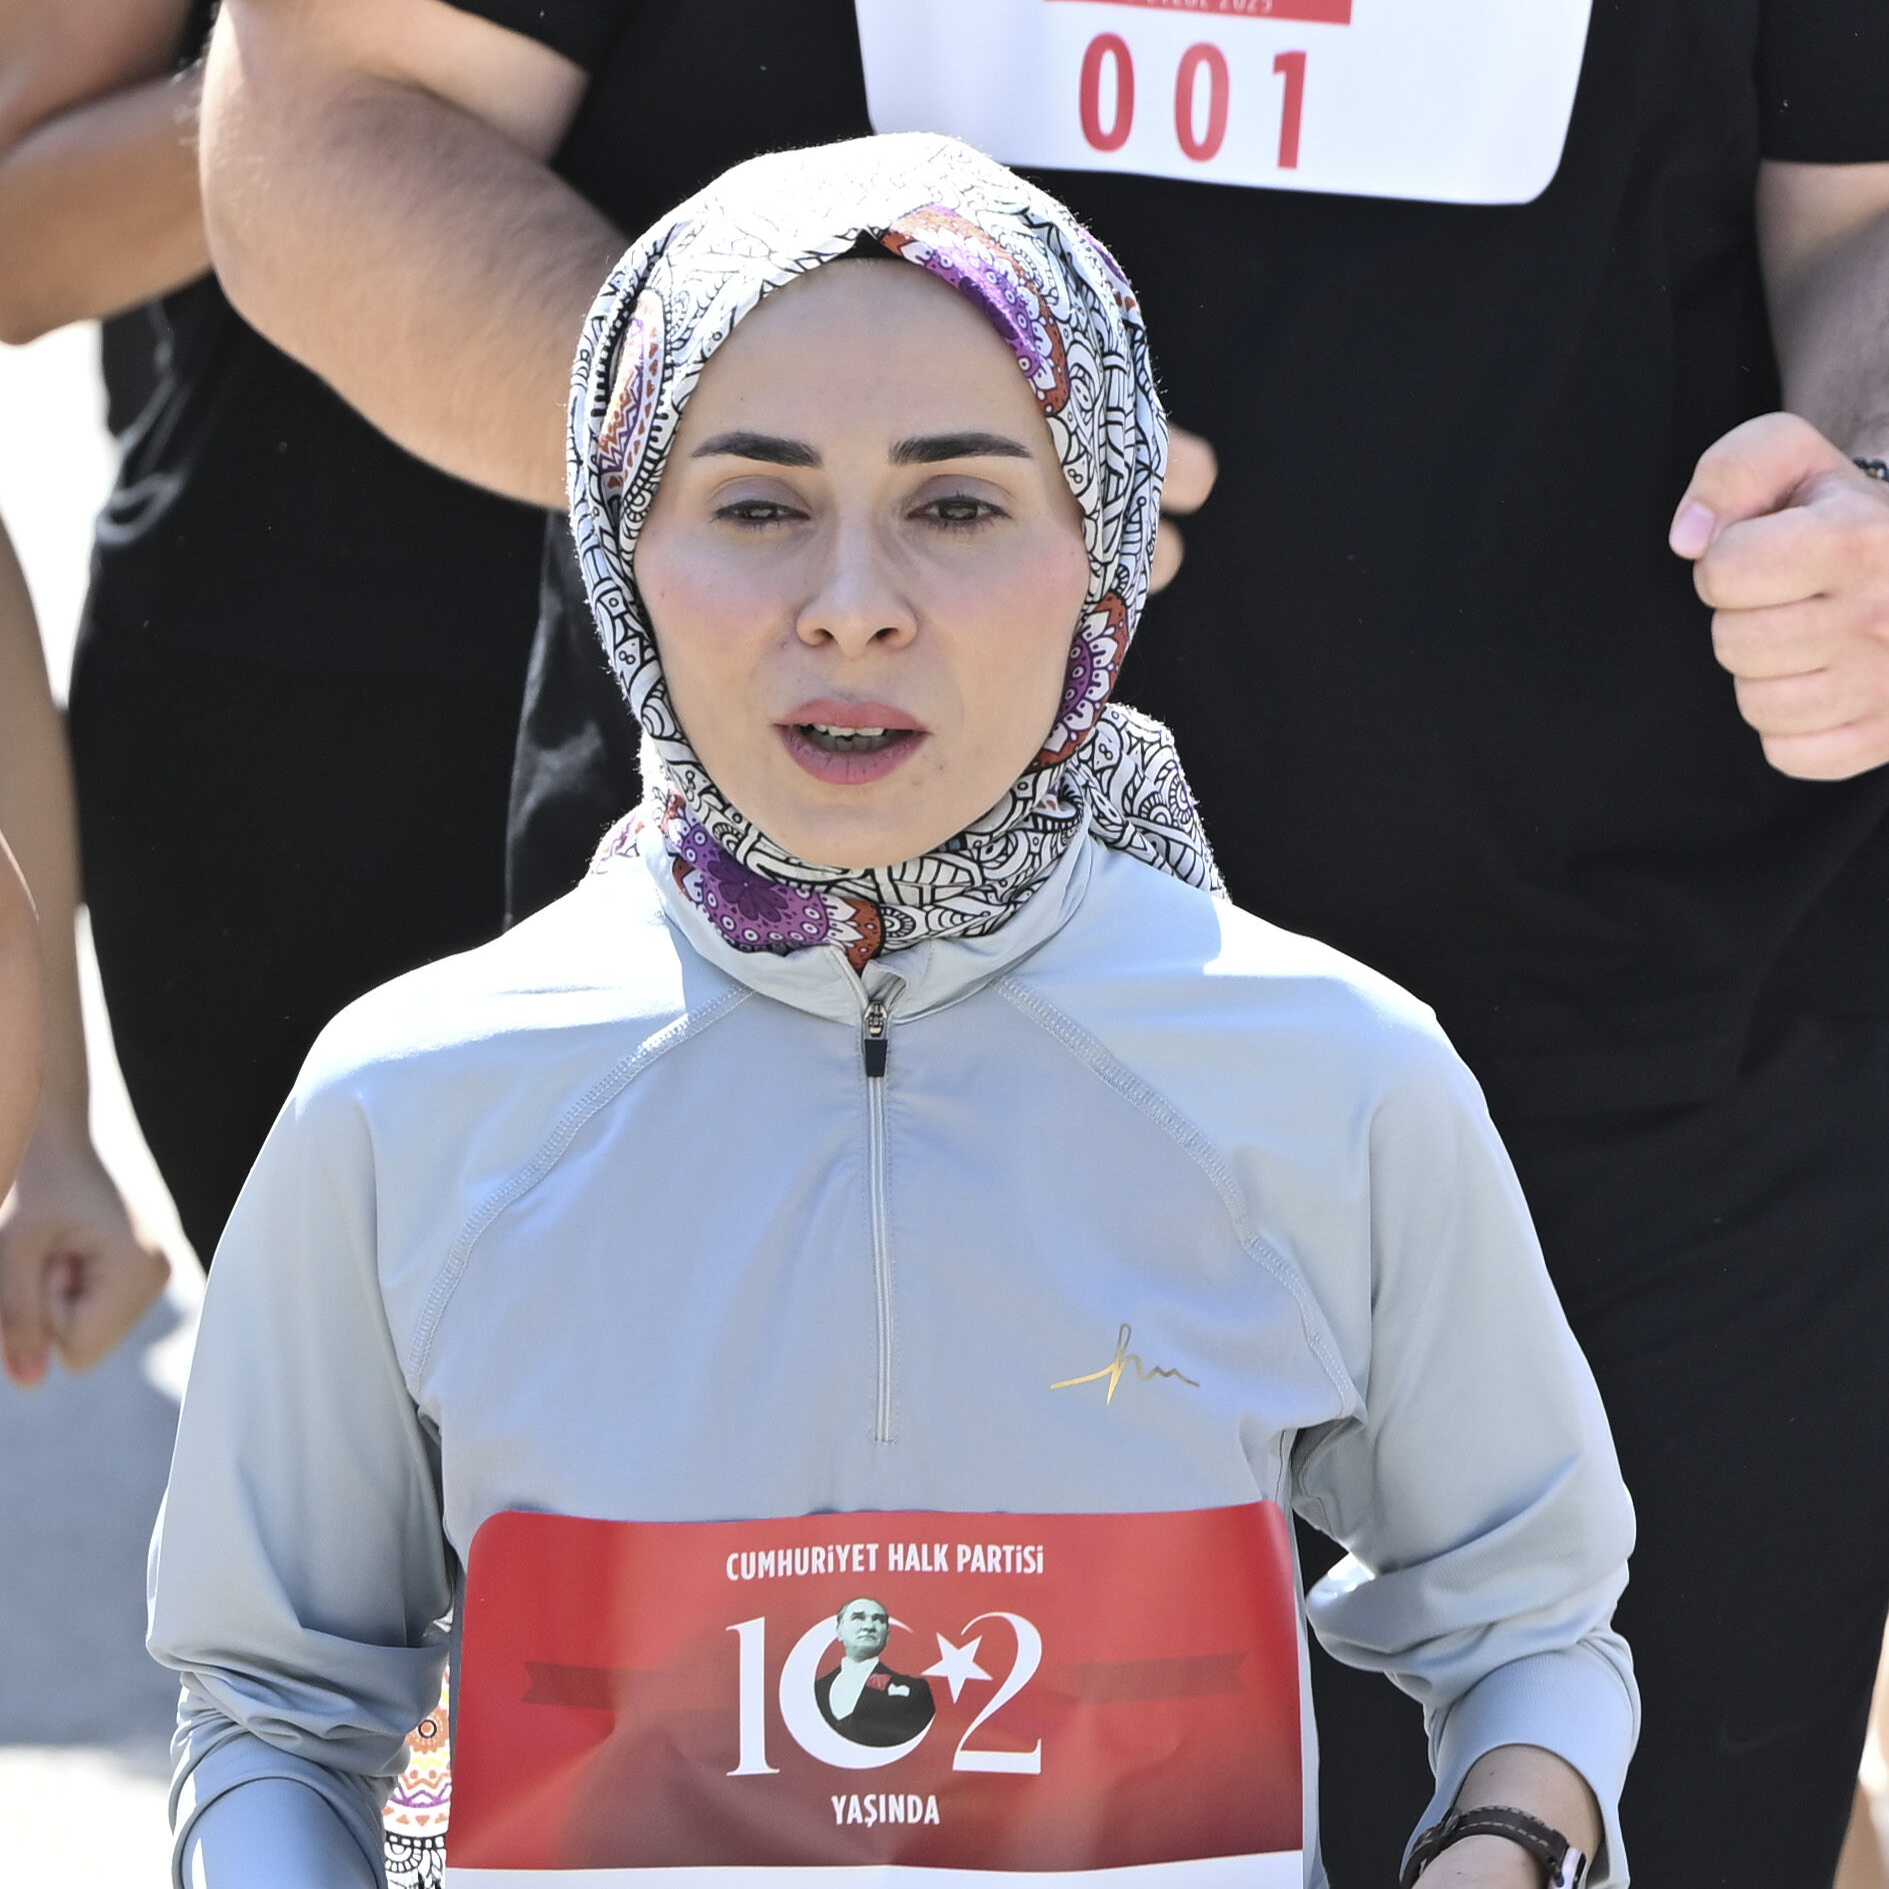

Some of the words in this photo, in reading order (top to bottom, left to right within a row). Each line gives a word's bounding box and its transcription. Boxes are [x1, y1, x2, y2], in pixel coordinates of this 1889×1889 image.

[1079, 32, 1308, 170] 001
[888, 1542, 950, 1573] HALK
[831, 1793, 941, 1828] YAŞINDA
